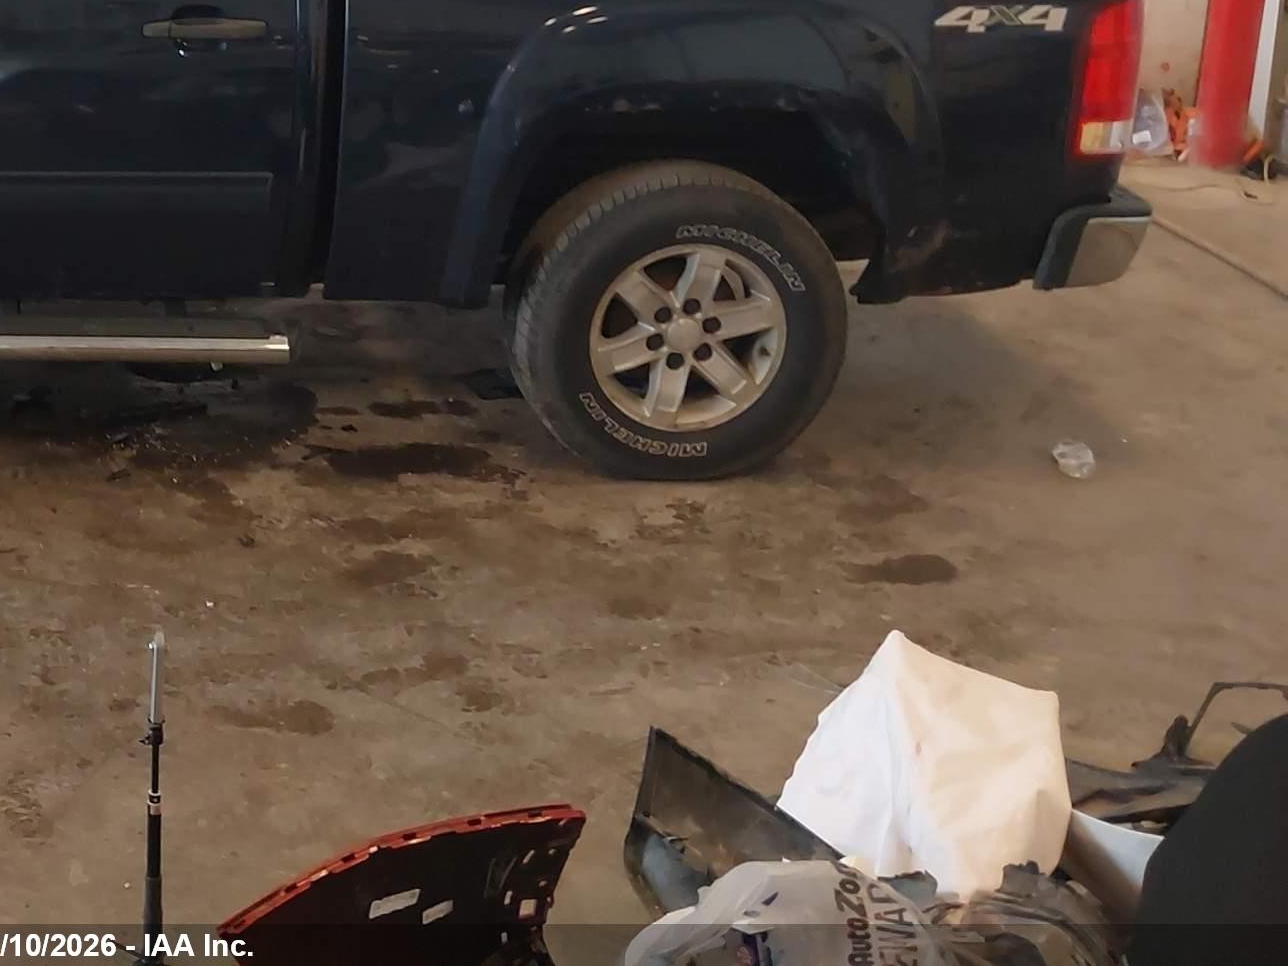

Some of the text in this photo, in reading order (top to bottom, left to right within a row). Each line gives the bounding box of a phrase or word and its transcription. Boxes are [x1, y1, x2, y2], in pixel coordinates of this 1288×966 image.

[675, 224, 807, 293] MICHELIN
[578, 390, 708, 458] MICHELIN
[831, 859, 874, 966] AutoZon
